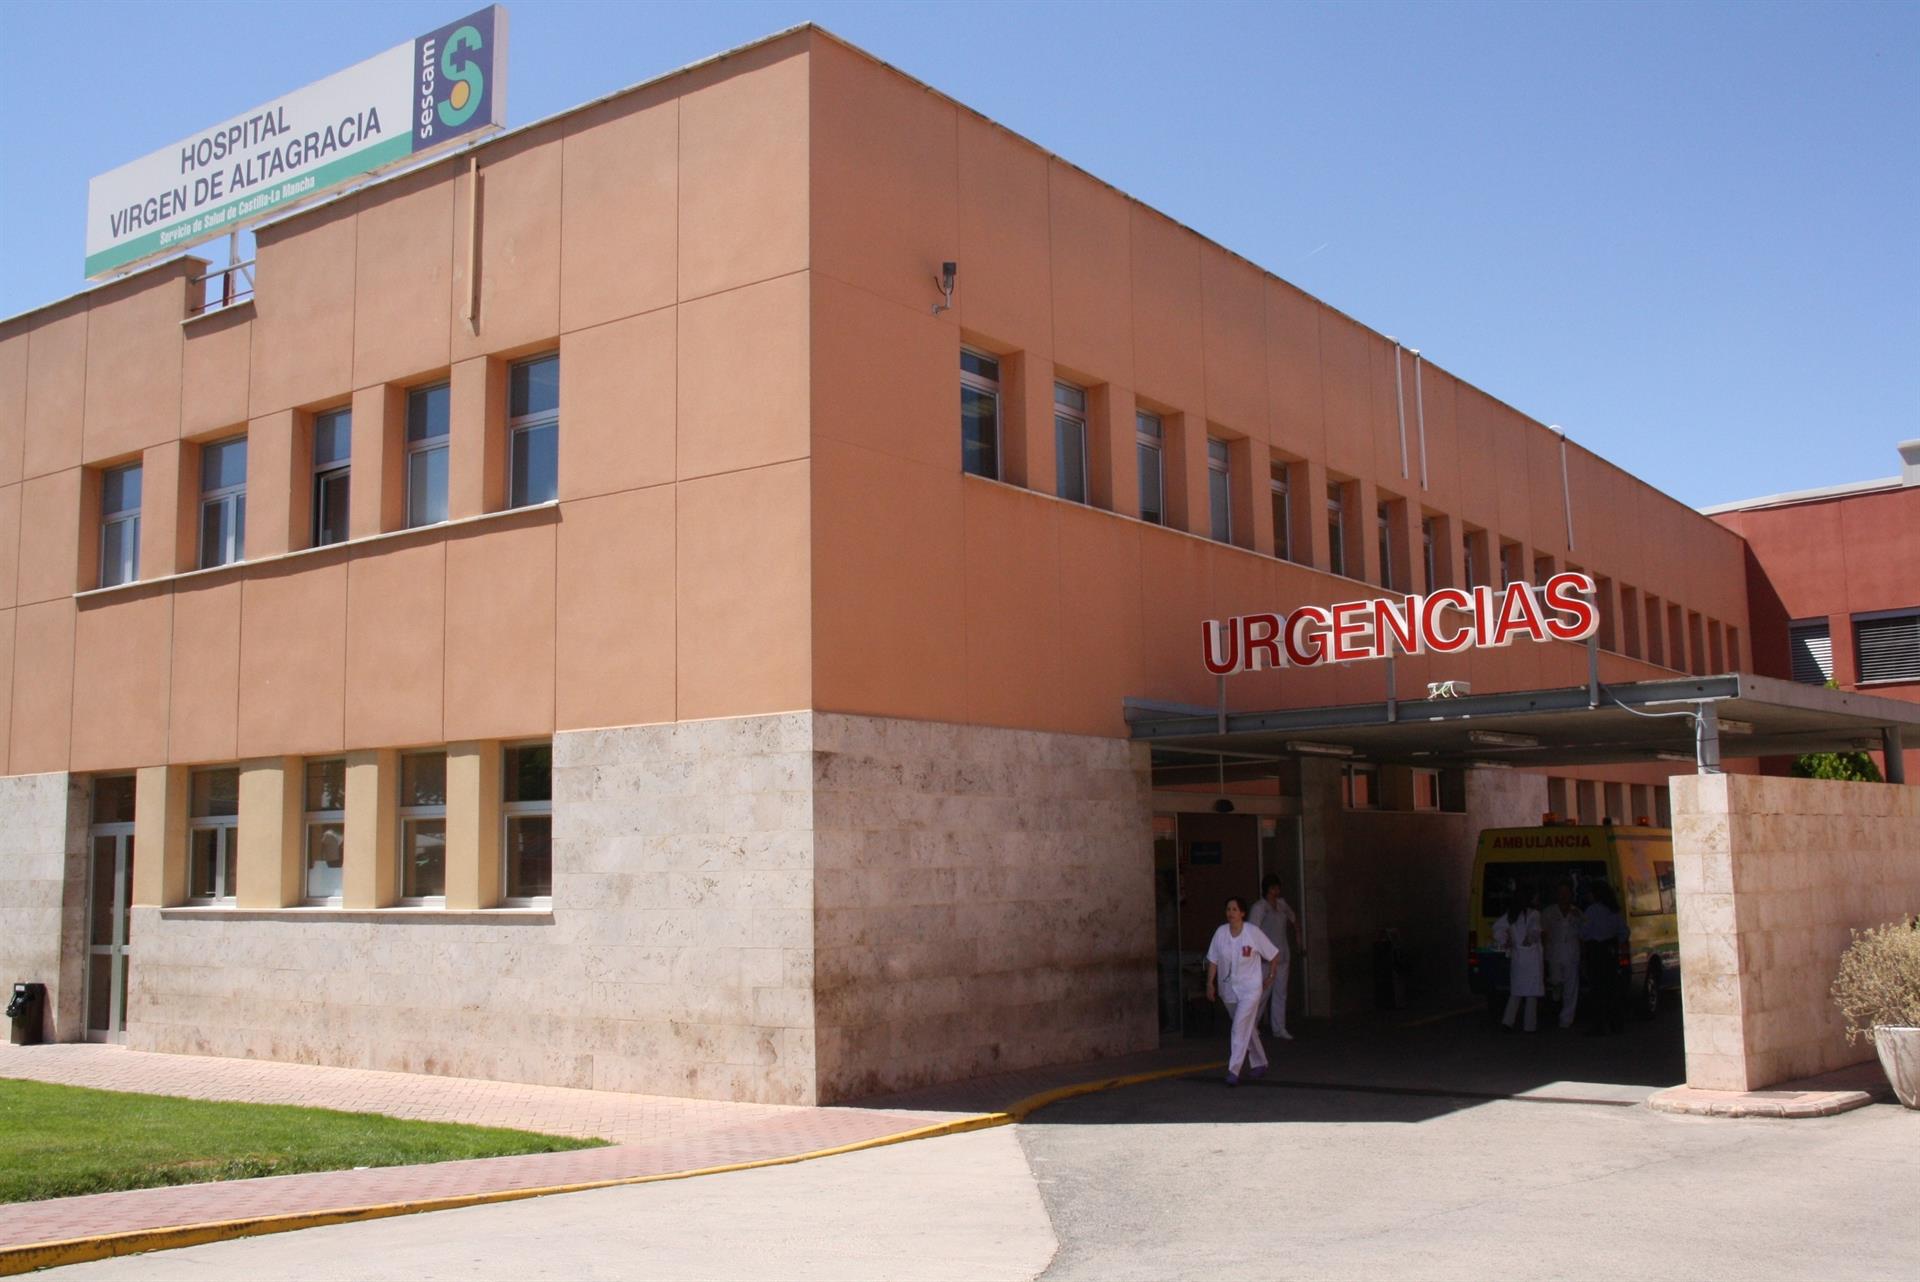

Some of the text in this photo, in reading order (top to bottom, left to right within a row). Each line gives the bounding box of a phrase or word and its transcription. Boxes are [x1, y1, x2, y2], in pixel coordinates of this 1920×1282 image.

[420, 38, 435, 139] sescam
[110, 106, 381, 239] VIRGEN DE ALTAGRACIA
[180, 106, 291, 175] HOSPITAL
[160, 224, 192, 245] Servicio
[193, 217, 203, 229] de
[204, 208, 225, 228] Salud
[227, 206, 237, 218] de
[282, 176, 315, 198] Mancha
[1202, 572, 1599, 676] URGENCIAS
[1492, 835, 1592, 849] AMBULANCIA
